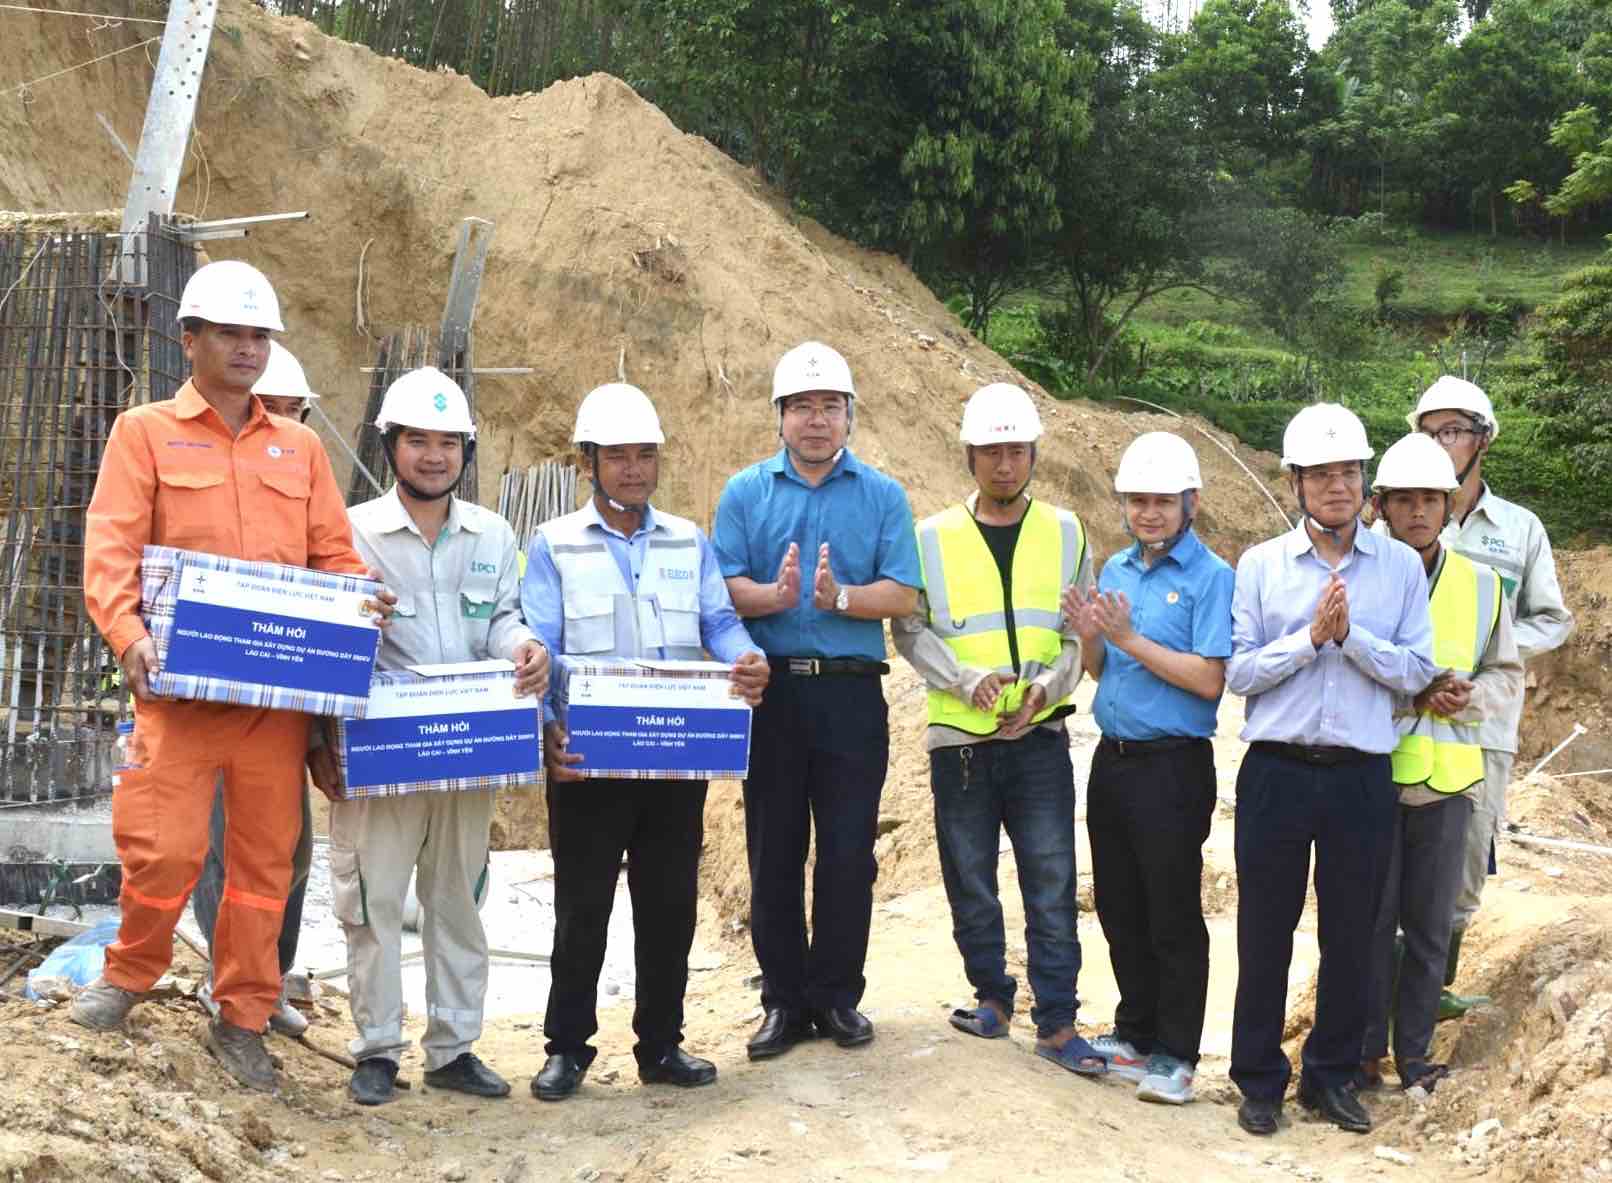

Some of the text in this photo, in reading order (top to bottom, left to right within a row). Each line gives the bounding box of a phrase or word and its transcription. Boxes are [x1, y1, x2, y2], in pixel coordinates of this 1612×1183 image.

[252, 621, 307, 639] THĂM HỎI
[200, 632, 213, 640] LAO
[234, 636, 251, 645] THAM
[417, 720, 470, 735] THĂM HỎI
[635, 714, 685, 727] THĂM HỎI
